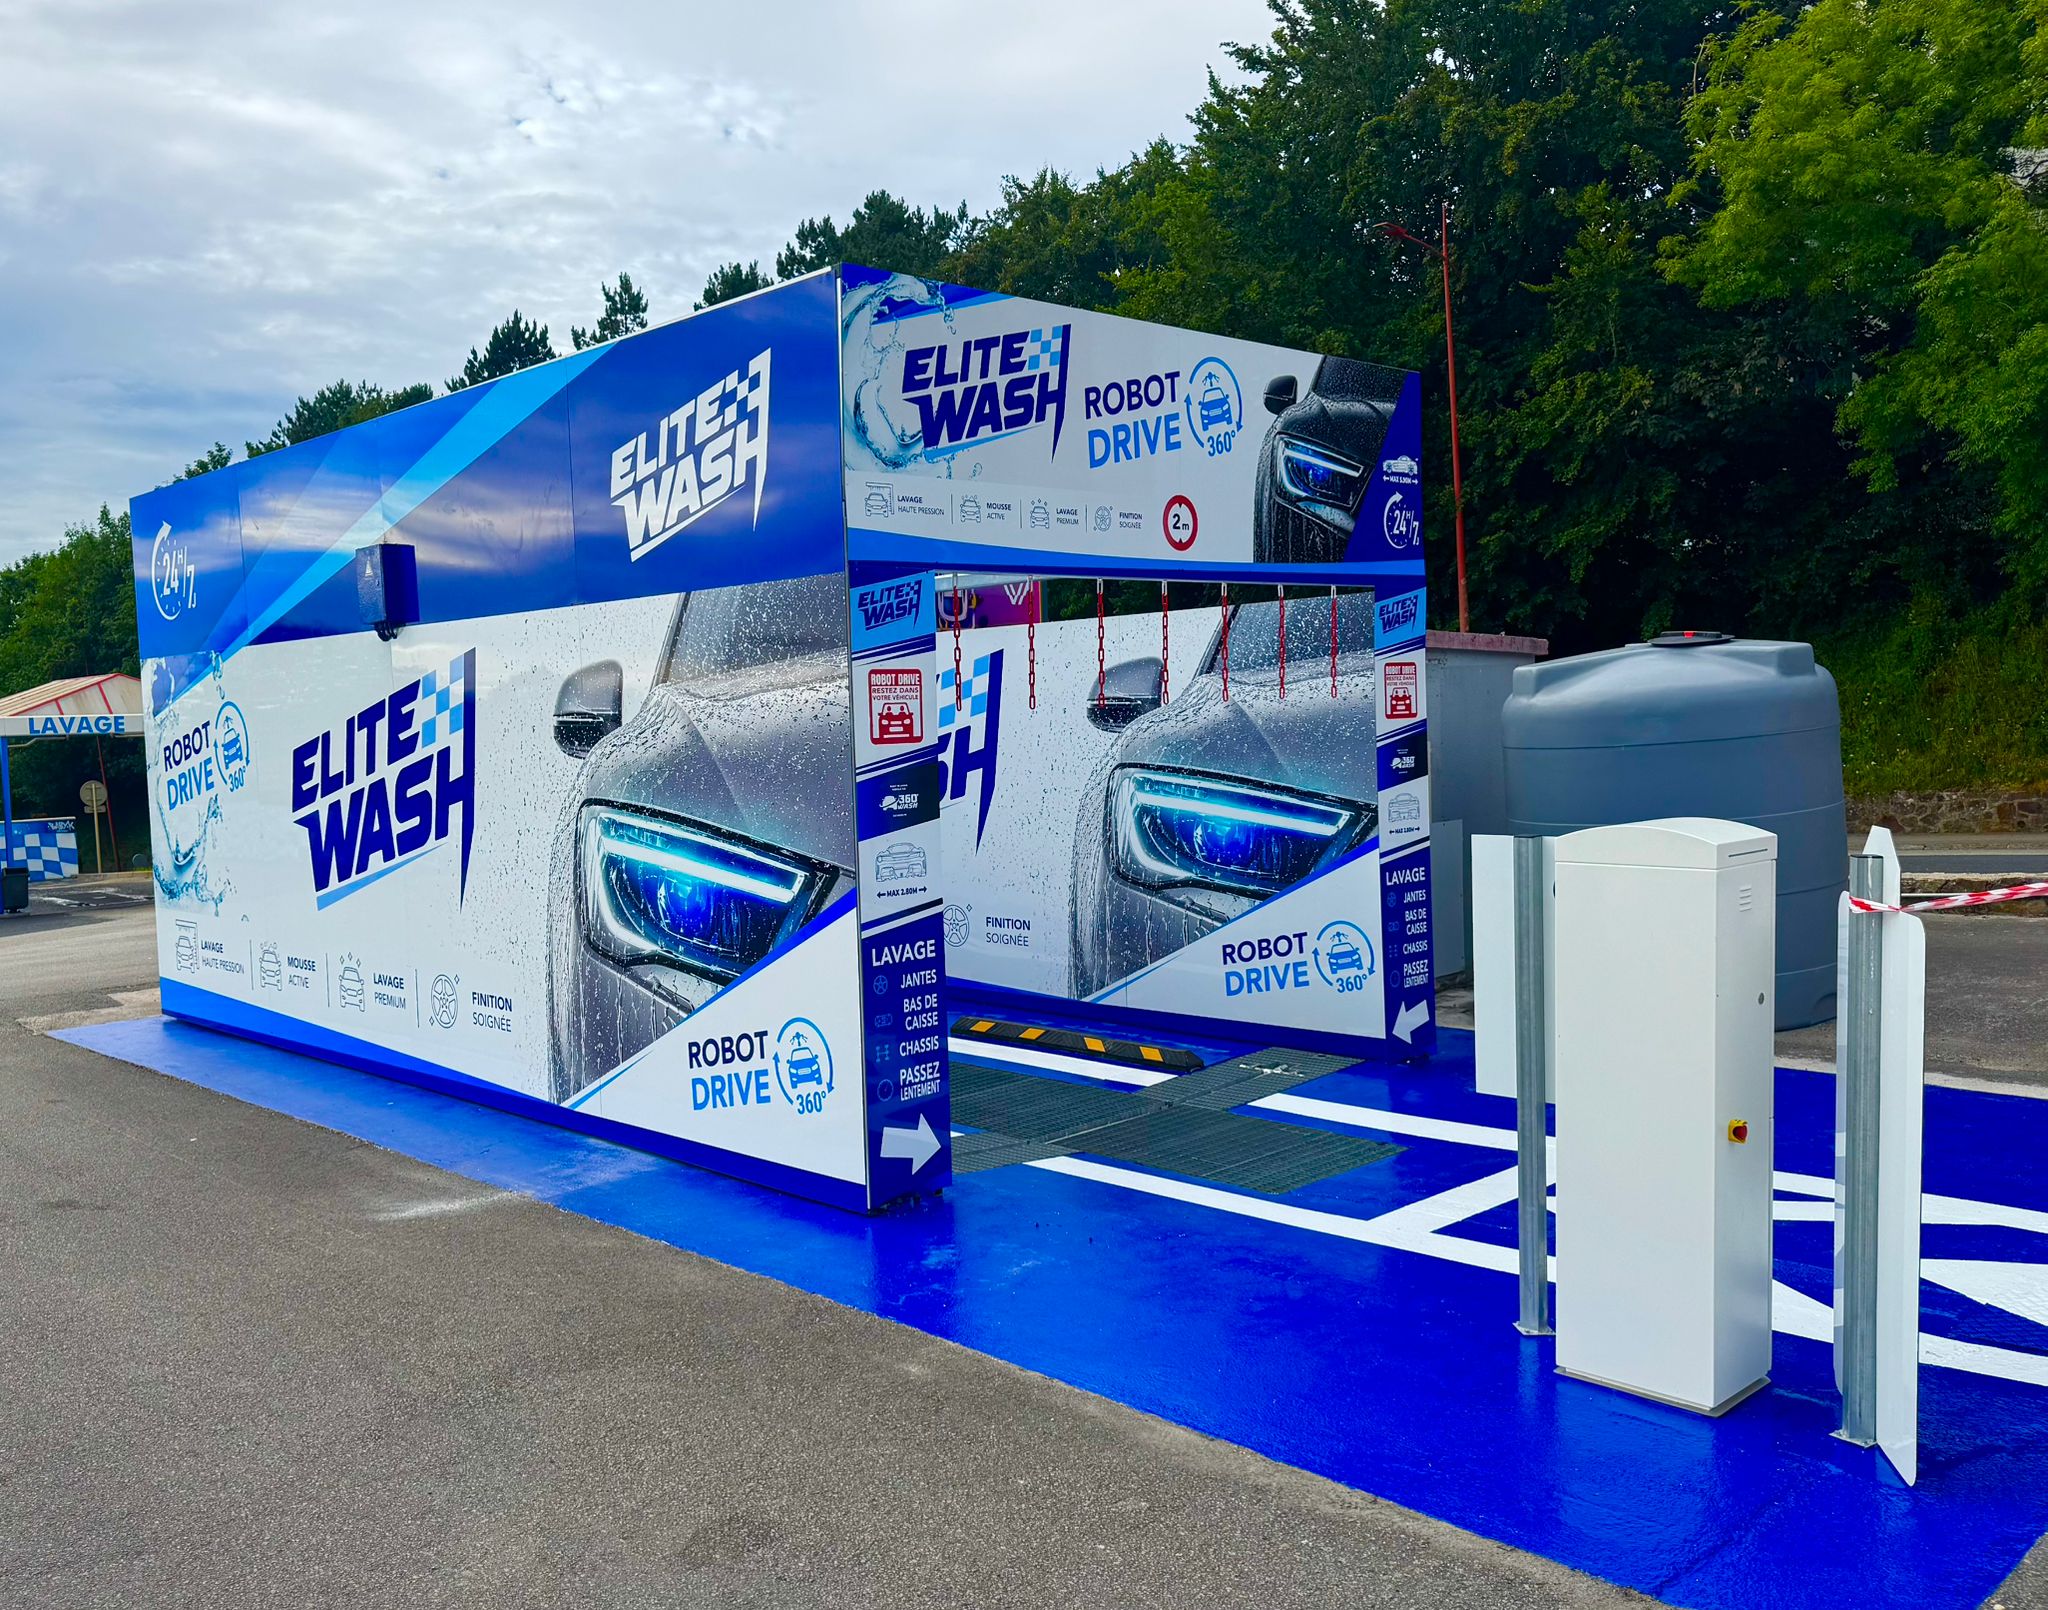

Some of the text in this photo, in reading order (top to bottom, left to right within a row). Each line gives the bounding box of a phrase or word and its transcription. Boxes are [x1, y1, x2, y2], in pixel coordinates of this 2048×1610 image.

[902, 331, 1030, 393] ELITE
[903, 324, 1071, 463] WASH
[1085, 371, 1180, 419] ROBOT
[611, 379, 725, 499] ELITE
[611, 347, 771, 550] WASH
[1087, 412, 1181, 469] DRIVE
[1207, 429, 1237, 457] 360°
[897, 495, 923, 503] LAVAGE
[986, 502, 1012, 511] MOUSSE
[898, 506, 945, 516] HAUTE PRESSION
[986, 512, 1005, 520] ACTIVE
[1056, 508, 1078, 516] LAVAGE
[1119, 511, 1143, 520] FINITION
[1056, 517, 1079, 525] PREMIUM
[1119, 520, 1142, 530] SOIGNÉE
[858, 585, 905, 609] ELITE
[859, 580, 922, 629] WASH
[1379, 600, 1408, 618] ELITE
[1380, 595, 1418, 633] WASH
[871, 673, 920, 686] ROBOT DRIVE
[872, 686, 919, 695] RESTEZ DANS
[891, 693, 918, 701] VÉHICULE
[29, 716, 125, 735] LAVAGE
[163, 720, 211, 772] ROBOT
[292, 679, 422, 815] ELITE
[166, 756, 215, 811] DRIVE
[228, 765, 247, 793] 360°
[292, 648, 476, 913] WASH
[1386, 867, 1426, 886] LAVAGE
[886, 888, 899, 897] MAX
[1404, 889, 1426, 903] JANTES
[985, 916, 1031, 931] FINITION
[1405, 908, 1427, 922] BAS DE
[1406, 922, 1427, 935] CAISSE
[201, 940, 224, 953] LAVAGE
[986, 931, 1029, 947] SOIGNÉE
[1222, 931, 1308, 965] ROBOT
[1403, 940, 1428, 954] CHASSIS
[872, 939, 936, 966] LAVAGE
[202, 956, 245, 974] HAUTE PRESSION
[287, 956, 316, 972] MOUSSE
[1404, 959, 1428, 976] PASSEZ
[288, 974, 309, 989] ACTIVE
[373, 973, 404, 990] LAVAGE
[900, 969, 937, 989] JANTES
[1225, 960, 1310, 997] DRIVE
[1335, 973, 1368, 993] 360°
[1404, 973, 1428, 988] LENTEMENT
[374, 992, 406, 1010] PREMIUM
[472, 992, 513, 1012] FINITION
[903, 993, 938, 1012] BAS DE
[472, 1011, 512, 1032] SOIGNÉE
[905, 1011, 938, 1031] CAISSE
[688, 1030, 768, 1069] ROBOT
[899, 1035, 939, 1057] CHASSIS
[900, 1061, 940, 1085] PASSEZ
[691, 1069, 771, 1111] DRIVE
[900, 1079, 941, 1101] LENTEMENT
[796, 1090, 827, 1115] 360°
